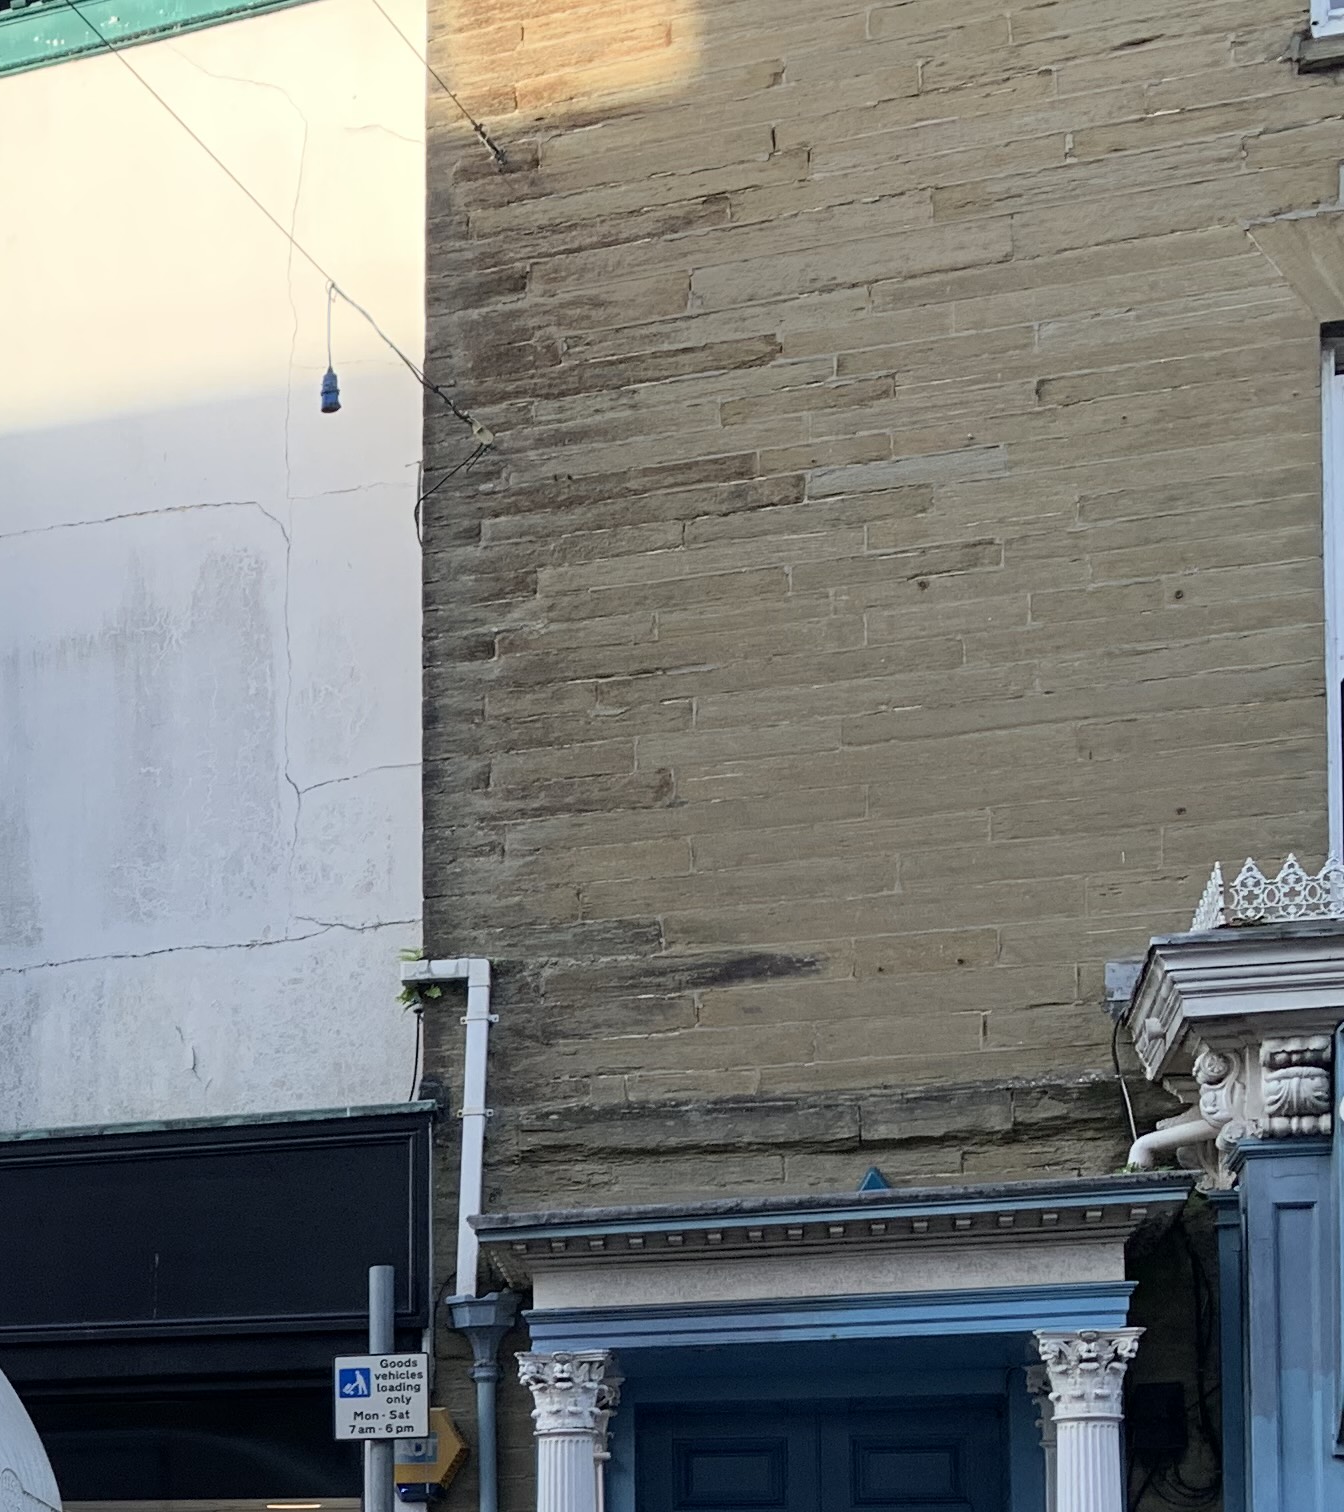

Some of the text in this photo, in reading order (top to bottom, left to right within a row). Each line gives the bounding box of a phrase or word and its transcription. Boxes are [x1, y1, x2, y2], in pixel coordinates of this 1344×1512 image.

[379, 1358, 418, 1369] Goods
[374, 1371, 423, 1380] vehicles
[376, 1382, 421, 1393] loading
[386, 1394, 412, 1405] only
[353, 1411, 379, 1421] Mon
[389, 1410, 410, 1420] Sat
[349, 1425, 356, 1434] 7
[357, 1425, 376, 1434] am
[385, 1424, 393, 1433] 6
[396, 1425, 414, 1434] pm
